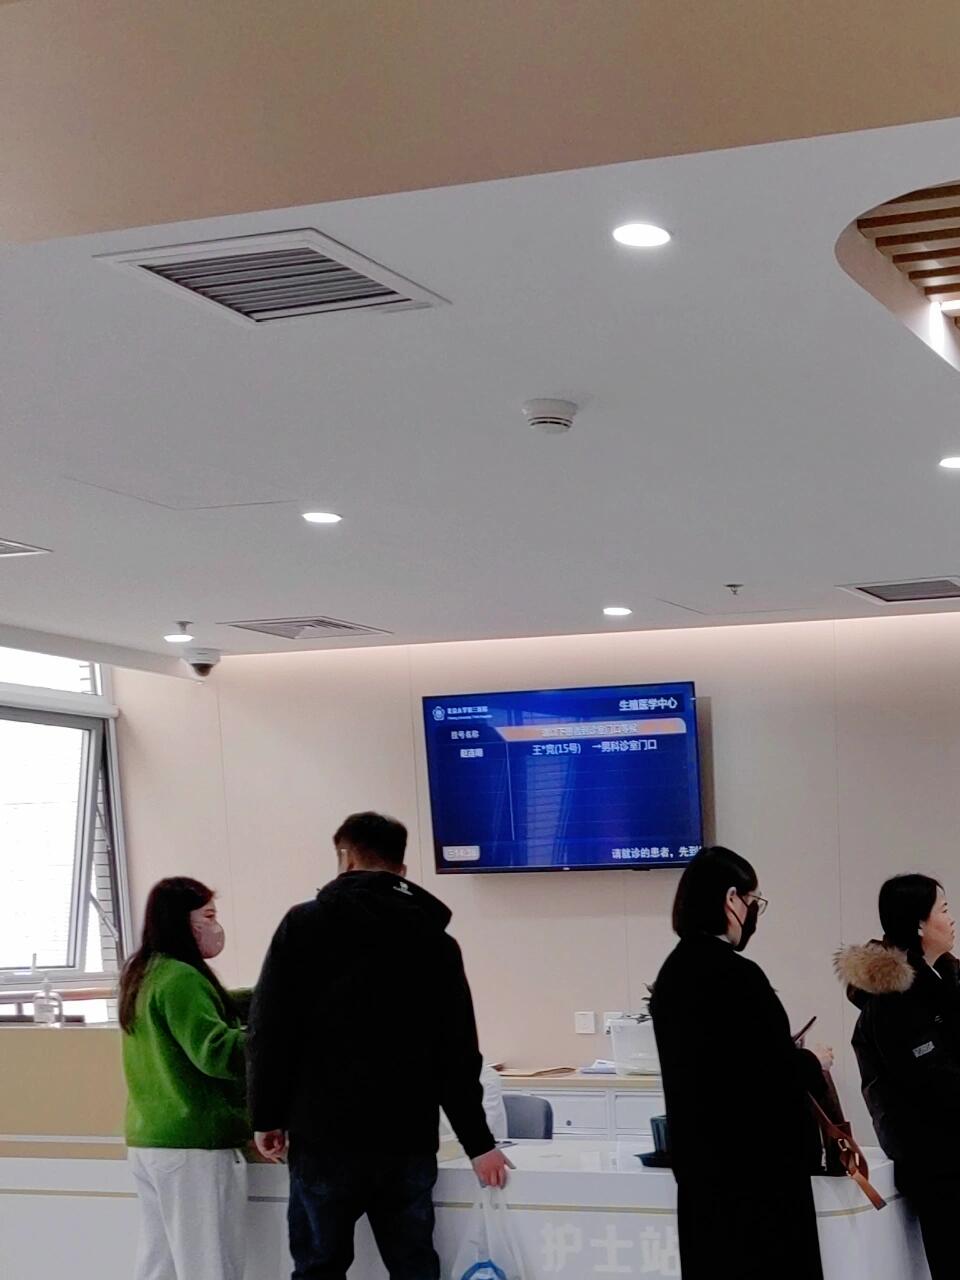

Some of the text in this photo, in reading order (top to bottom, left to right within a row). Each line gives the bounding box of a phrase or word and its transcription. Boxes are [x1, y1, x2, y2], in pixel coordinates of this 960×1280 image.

[619, 697, 677, 711] 生殖医学中心
[612, 845, 701, 859] 请就诊的患者，先到
[540, 1223, 681, 1277] 护士站
